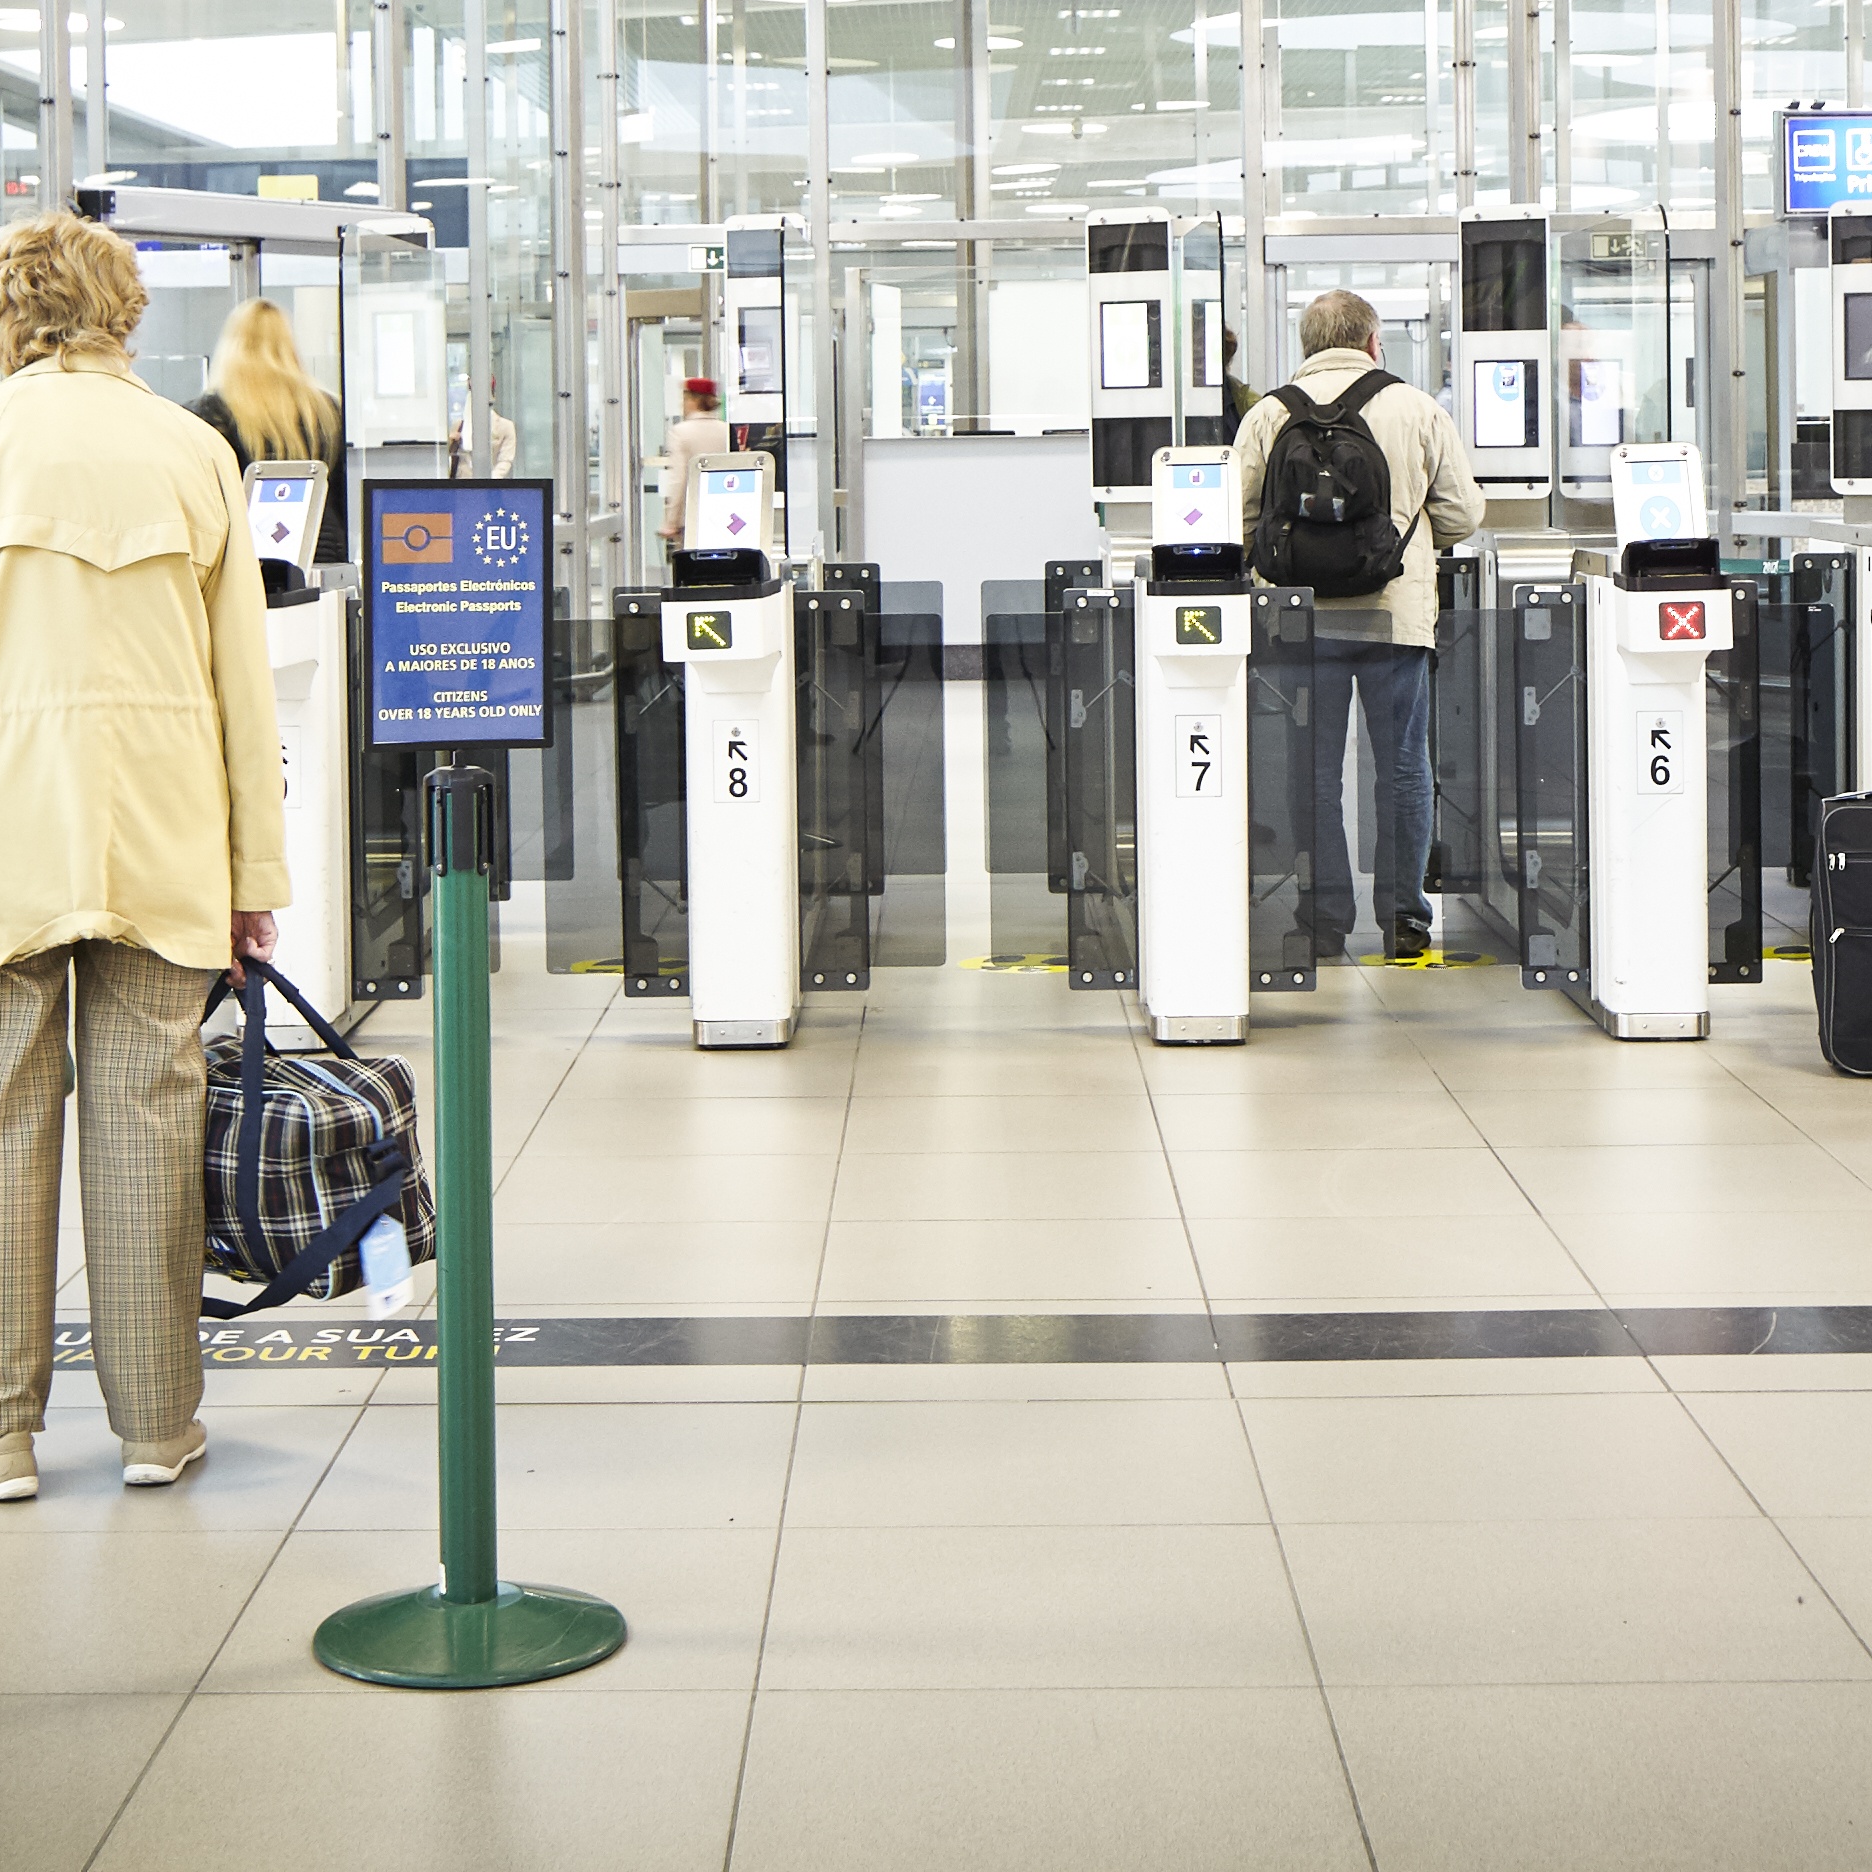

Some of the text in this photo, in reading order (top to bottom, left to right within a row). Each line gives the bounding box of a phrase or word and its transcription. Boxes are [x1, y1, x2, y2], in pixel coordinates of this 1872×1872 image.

[486, 526, 517, 550] EU
[381, 581, 458, 595] Passaportes
[396, 600, 522, 614] Electronic Passports
[409, 642, 511, 656] USO EXCLUSIVO
[385, 657, 536, 672] A MAIORES DE 18 ANOS
[433, 690, 488, 703] CITIZENS
[378, 704, 542, 721] OVER 18 YEARS OLD ONLY
[1190, 761, 1211, 791] 7
[1649, 754, 1671, 786] 6
[728, 767, 748, 798] 8
[255, 1328, 295, 1344] A
[312, 1328, 420, 1344] SUA
